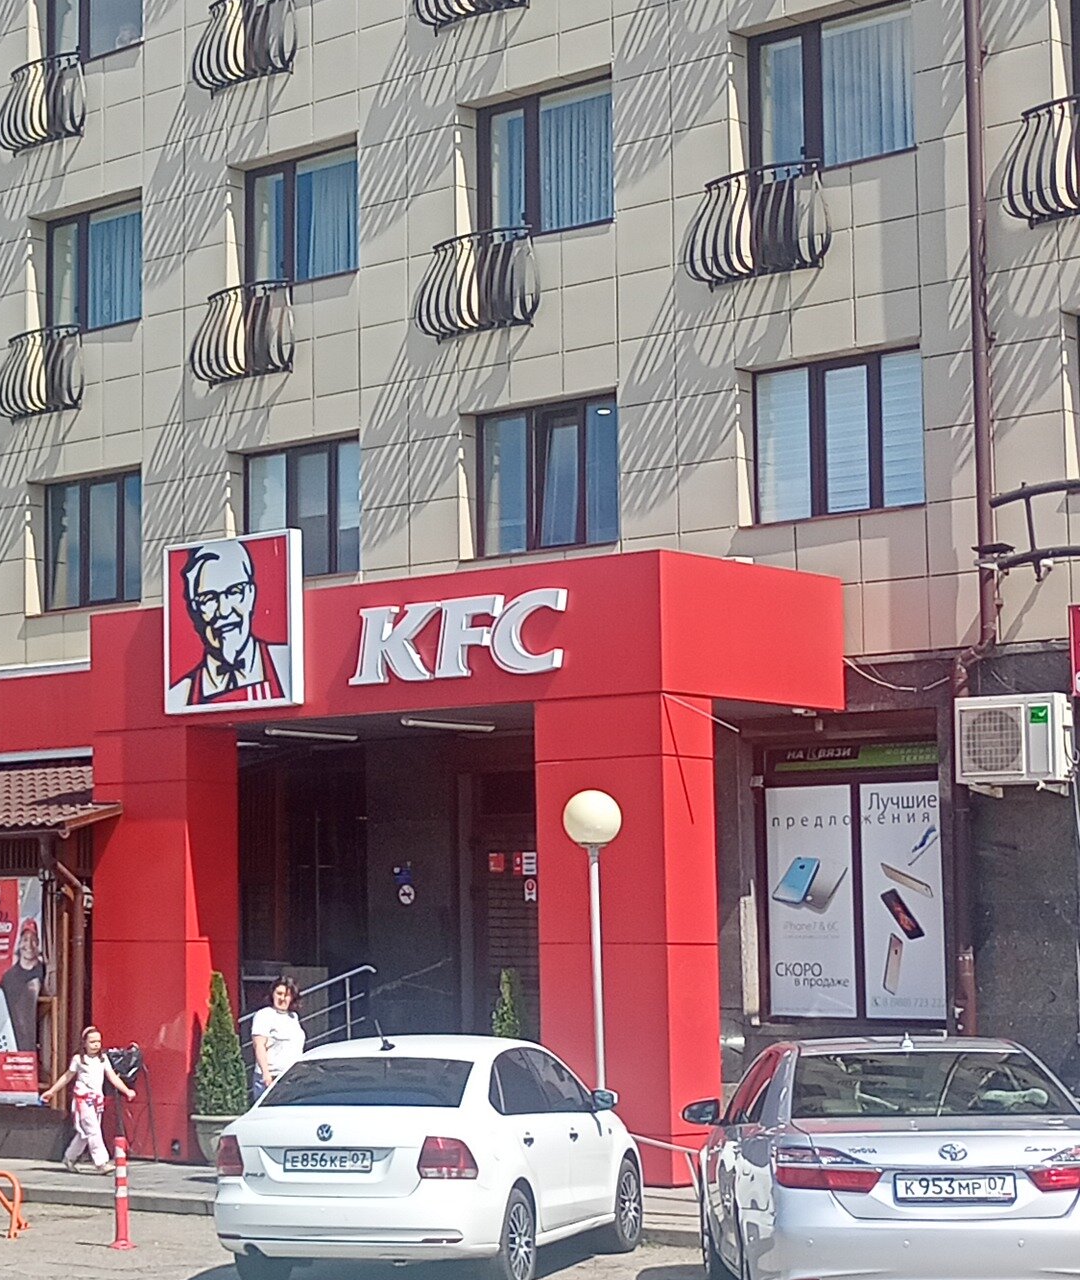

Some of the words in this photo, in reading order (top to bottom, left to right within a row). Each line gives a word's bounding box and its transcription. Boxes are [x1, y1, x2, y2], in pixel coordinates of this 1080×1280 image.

[348, 587, 568, 686] KFC
[868, 792, 938, 817] Лучшие
[775, 962, 822, 977] СКОРО
[802, 977, 850, 989] продаже
[351, 1153, 366, 1164] 07
[988, 1177, 1007, 1191] 07
